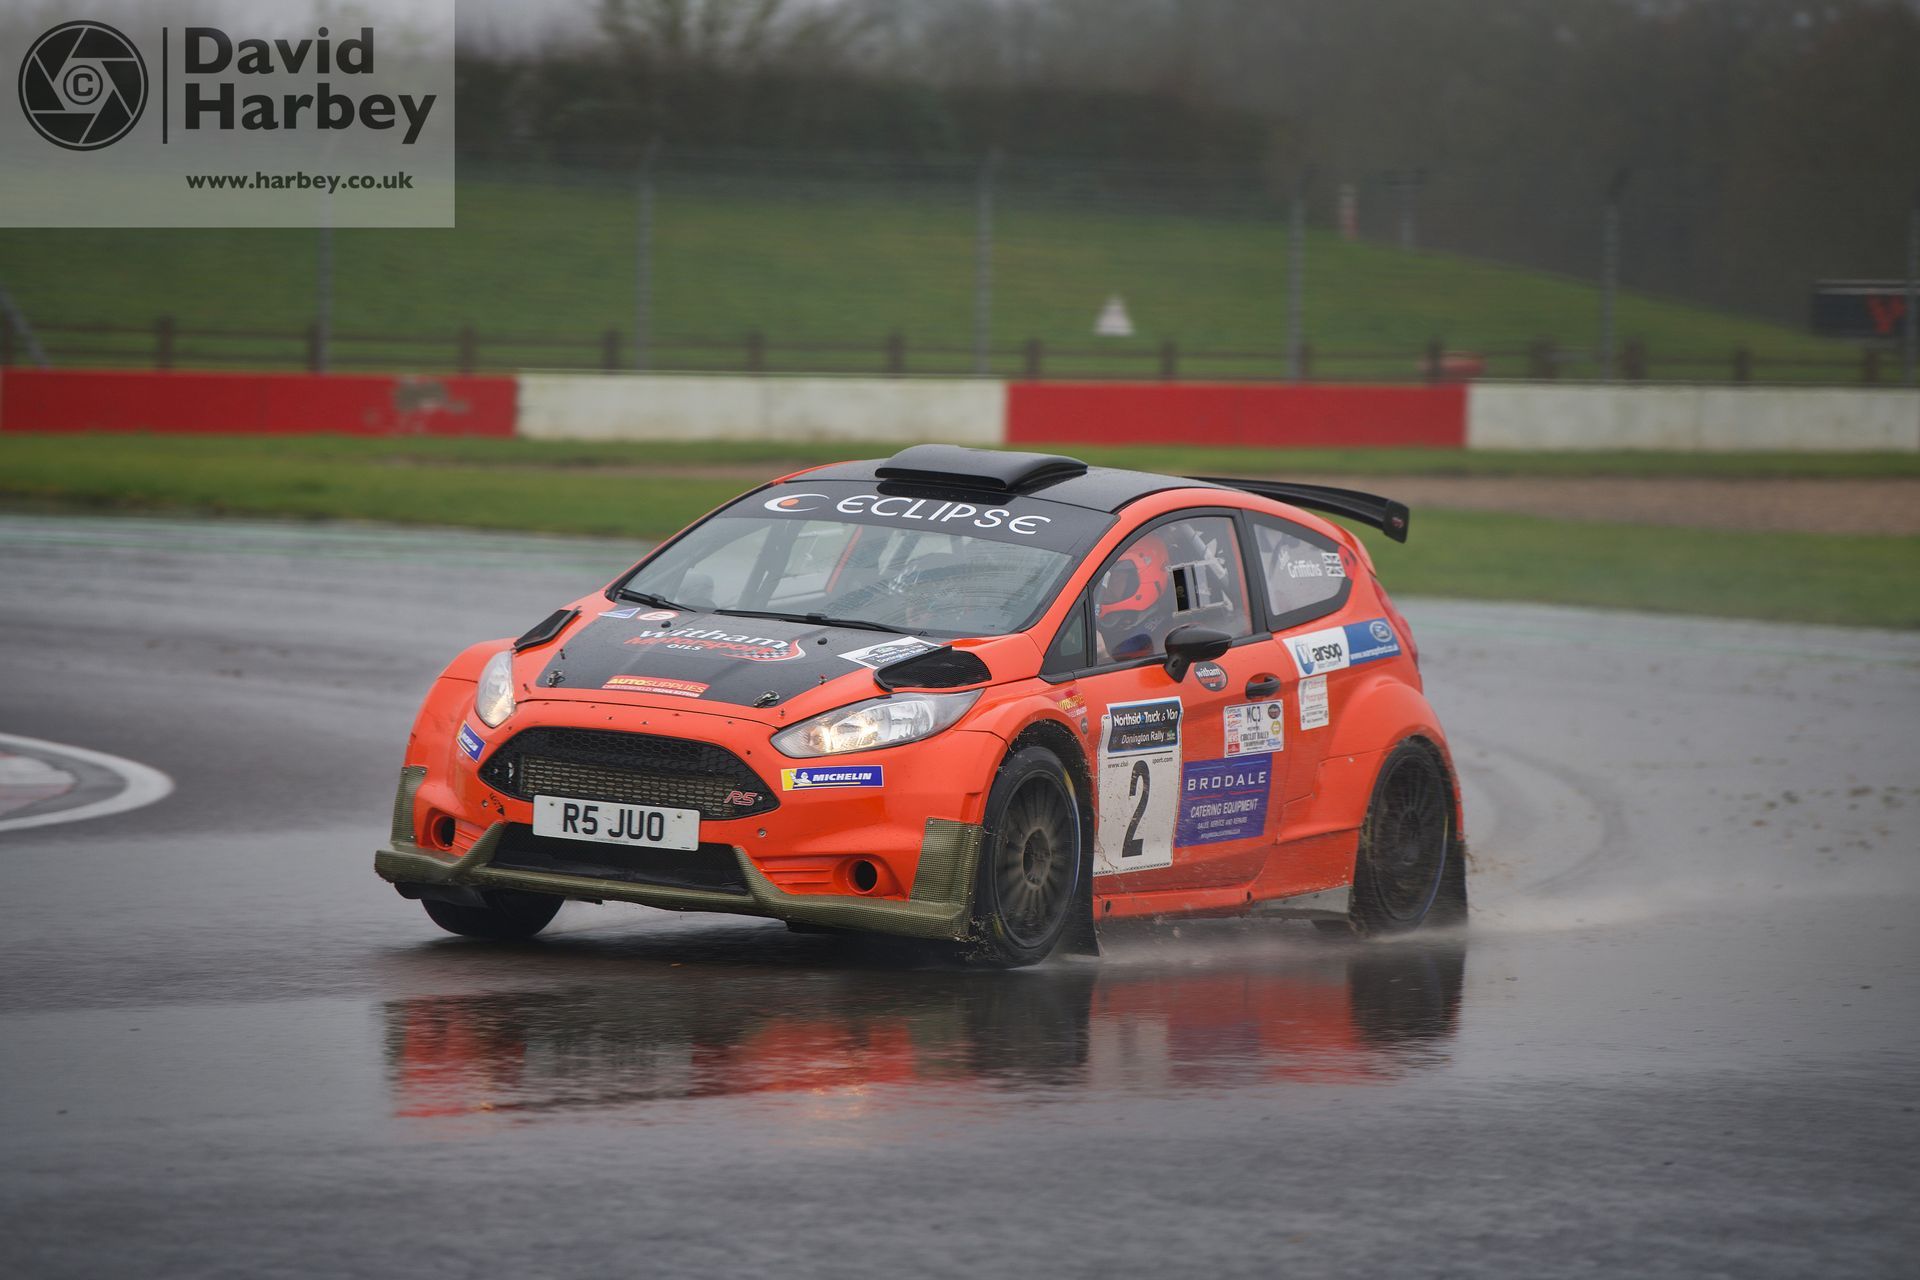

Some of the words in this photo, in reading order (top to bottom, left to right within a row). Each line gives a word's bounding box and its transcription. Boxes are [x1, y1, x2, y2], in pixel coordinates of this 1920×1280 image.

[836, 494, 1051, 535] ECLIPSE
[640, 627, 789, 648] witham
[1144, 710, 1161, 724] Truck
[1167, 709, 1178, 720] Van
[1121, 732, 1149, 745] Donington
[1151, 730, 1164, 742] Rally
[812, 773, 872, 781] MICHELIN
[1187, 771, 1266, 790] BRODALE
[1122, 761, 1150, 858] 2
[1191, 803, 1222, 818] CATERING
[1223, 799, 1258, 814] EQUIPMENT
[563, 803, 599, 835] R5
[608, 809, 665, 842] JUO
